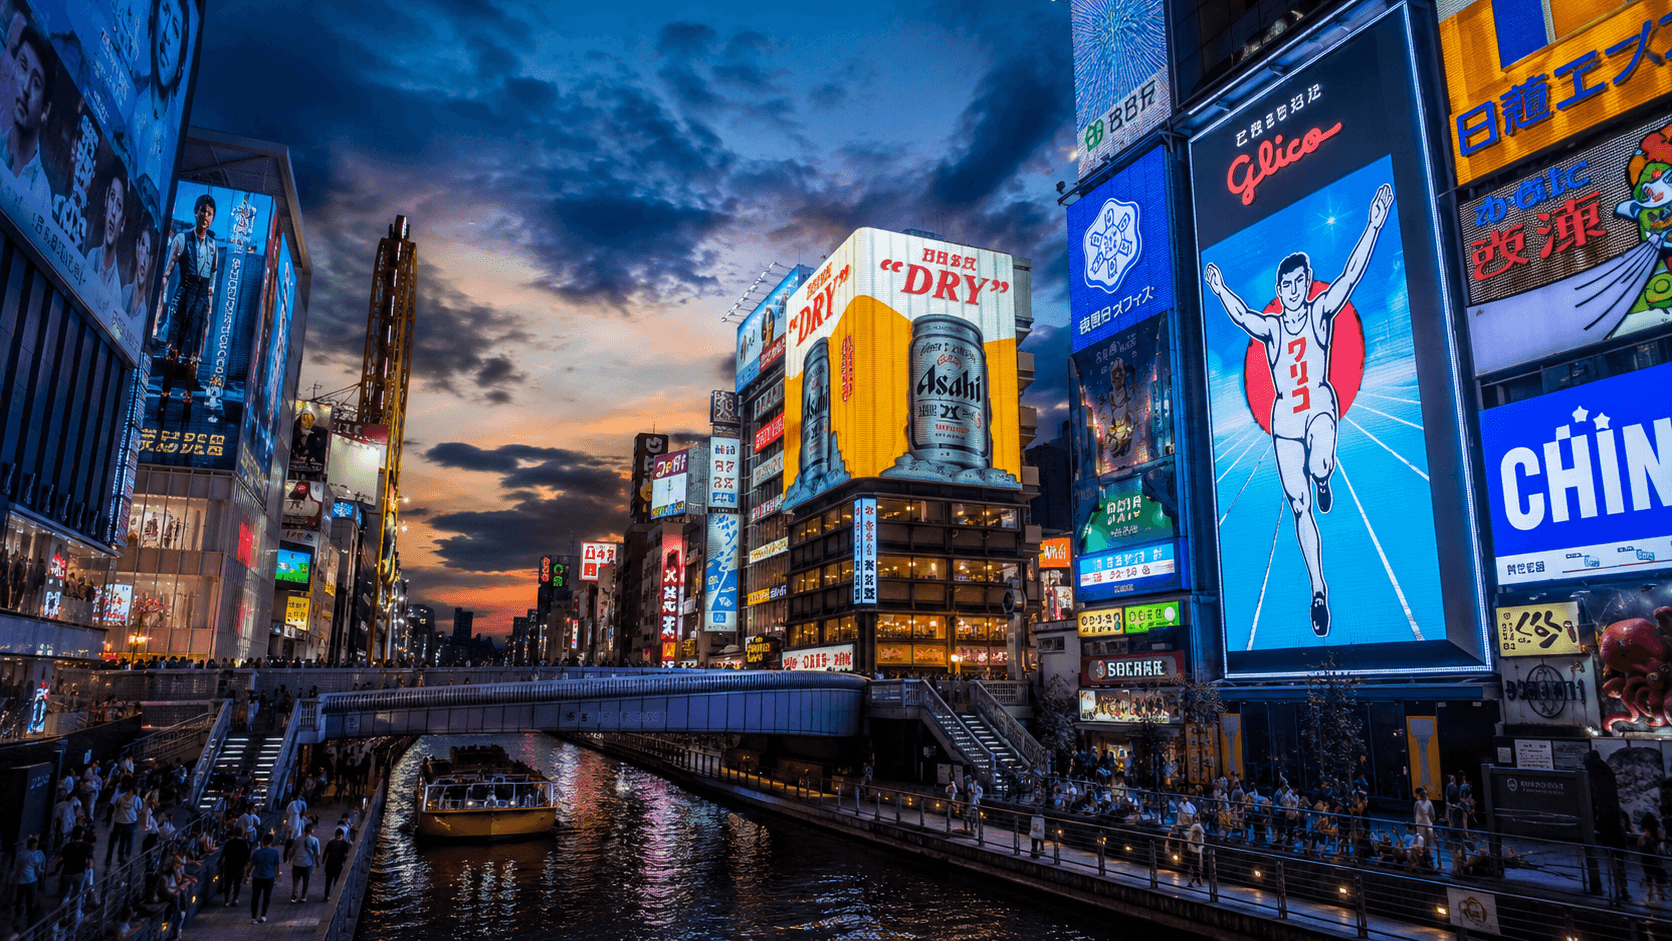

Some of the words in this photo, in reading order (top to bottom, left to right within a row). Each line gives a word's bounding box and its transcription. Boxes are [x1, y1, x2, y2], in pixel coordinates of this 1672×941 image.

[1226, 122, 1343, 206] Glico
[880, 258, 1010, 306] “DRY”
[916, 364, 981, 403] Asahi
